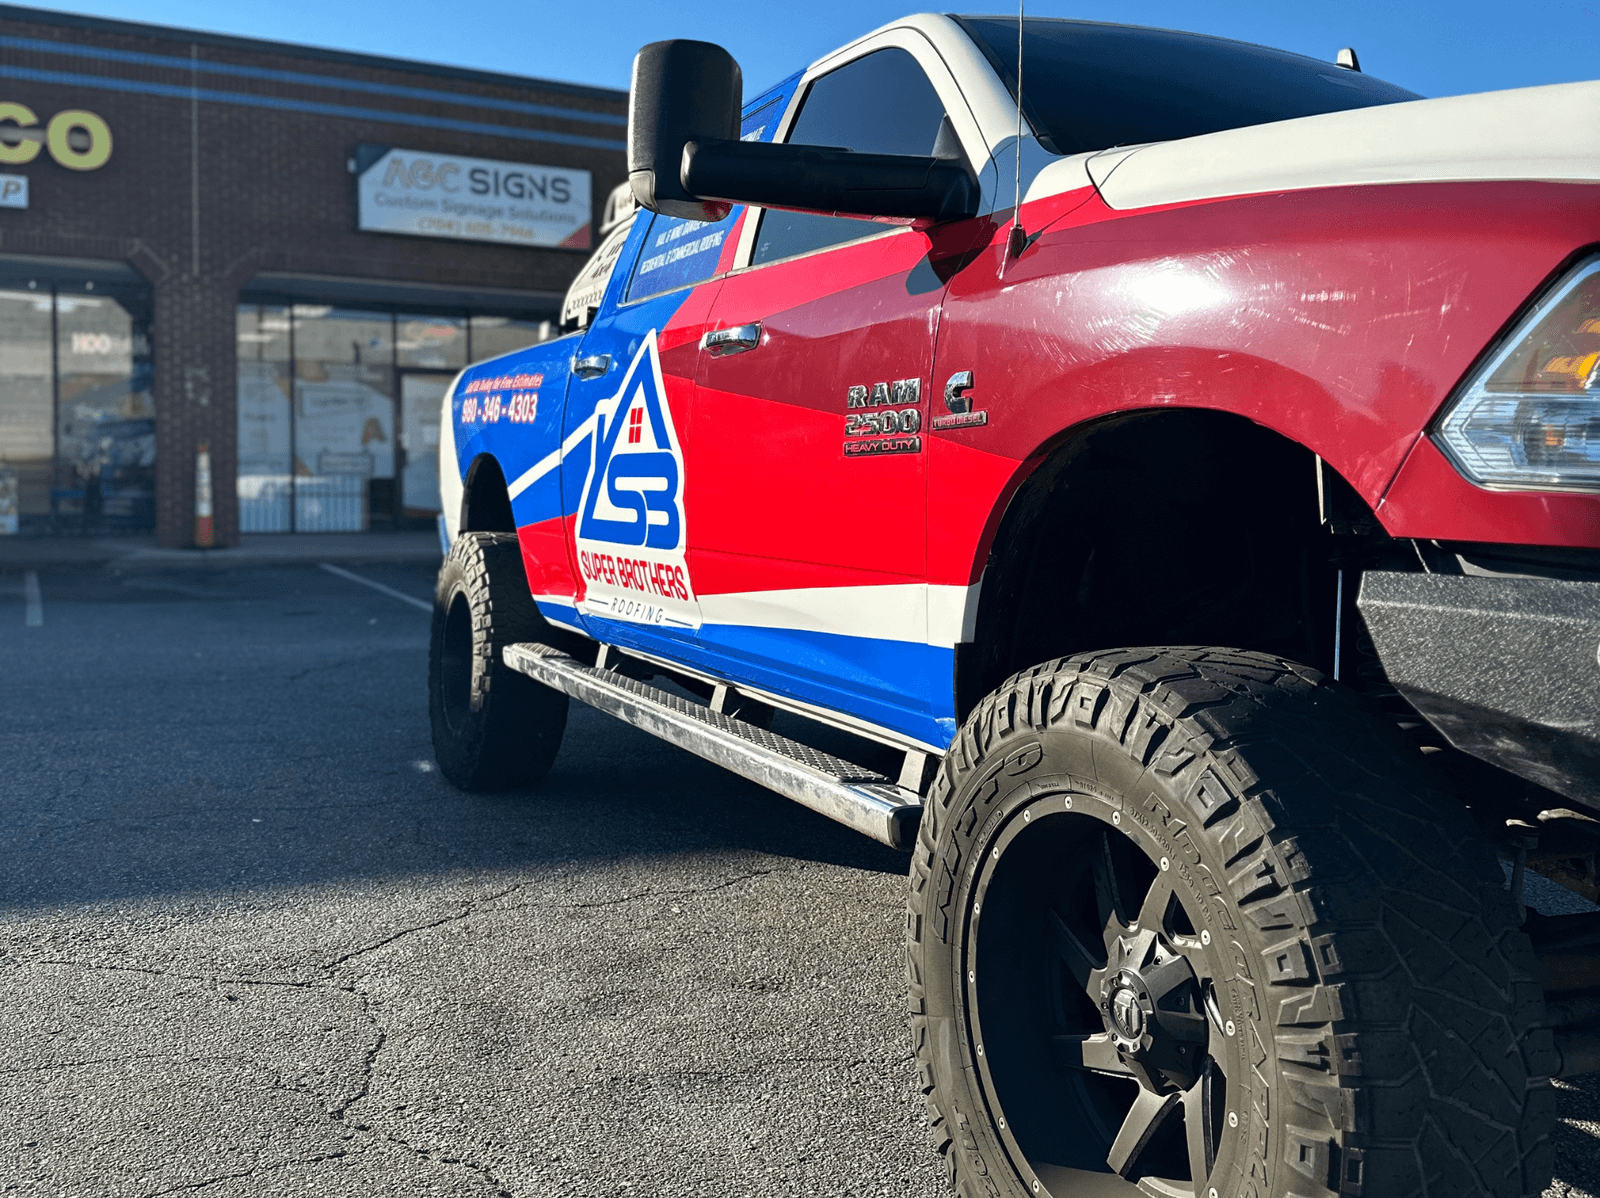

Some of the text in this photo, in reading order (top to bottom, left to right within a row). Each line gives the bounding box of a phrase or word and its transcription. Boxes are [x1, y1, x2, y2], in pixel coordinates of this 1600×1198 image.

[382, 157, 572, 205] AGC SIGNS
[374, 191, 577, 225] Custom Signage Solutions
[847, 378, 920, 409] RAM
[845, 408, 921, 437] 2500
[932, 412, 983, 428] TURBO DIESEL
[845, 439, 915, 454] HEAVY DUTY
[580, 550, 689, 601] SUPER BROTHERS
[611, 597, 664, 624] ROOFING
[1142, 791, 1236, 933] RIDGE
